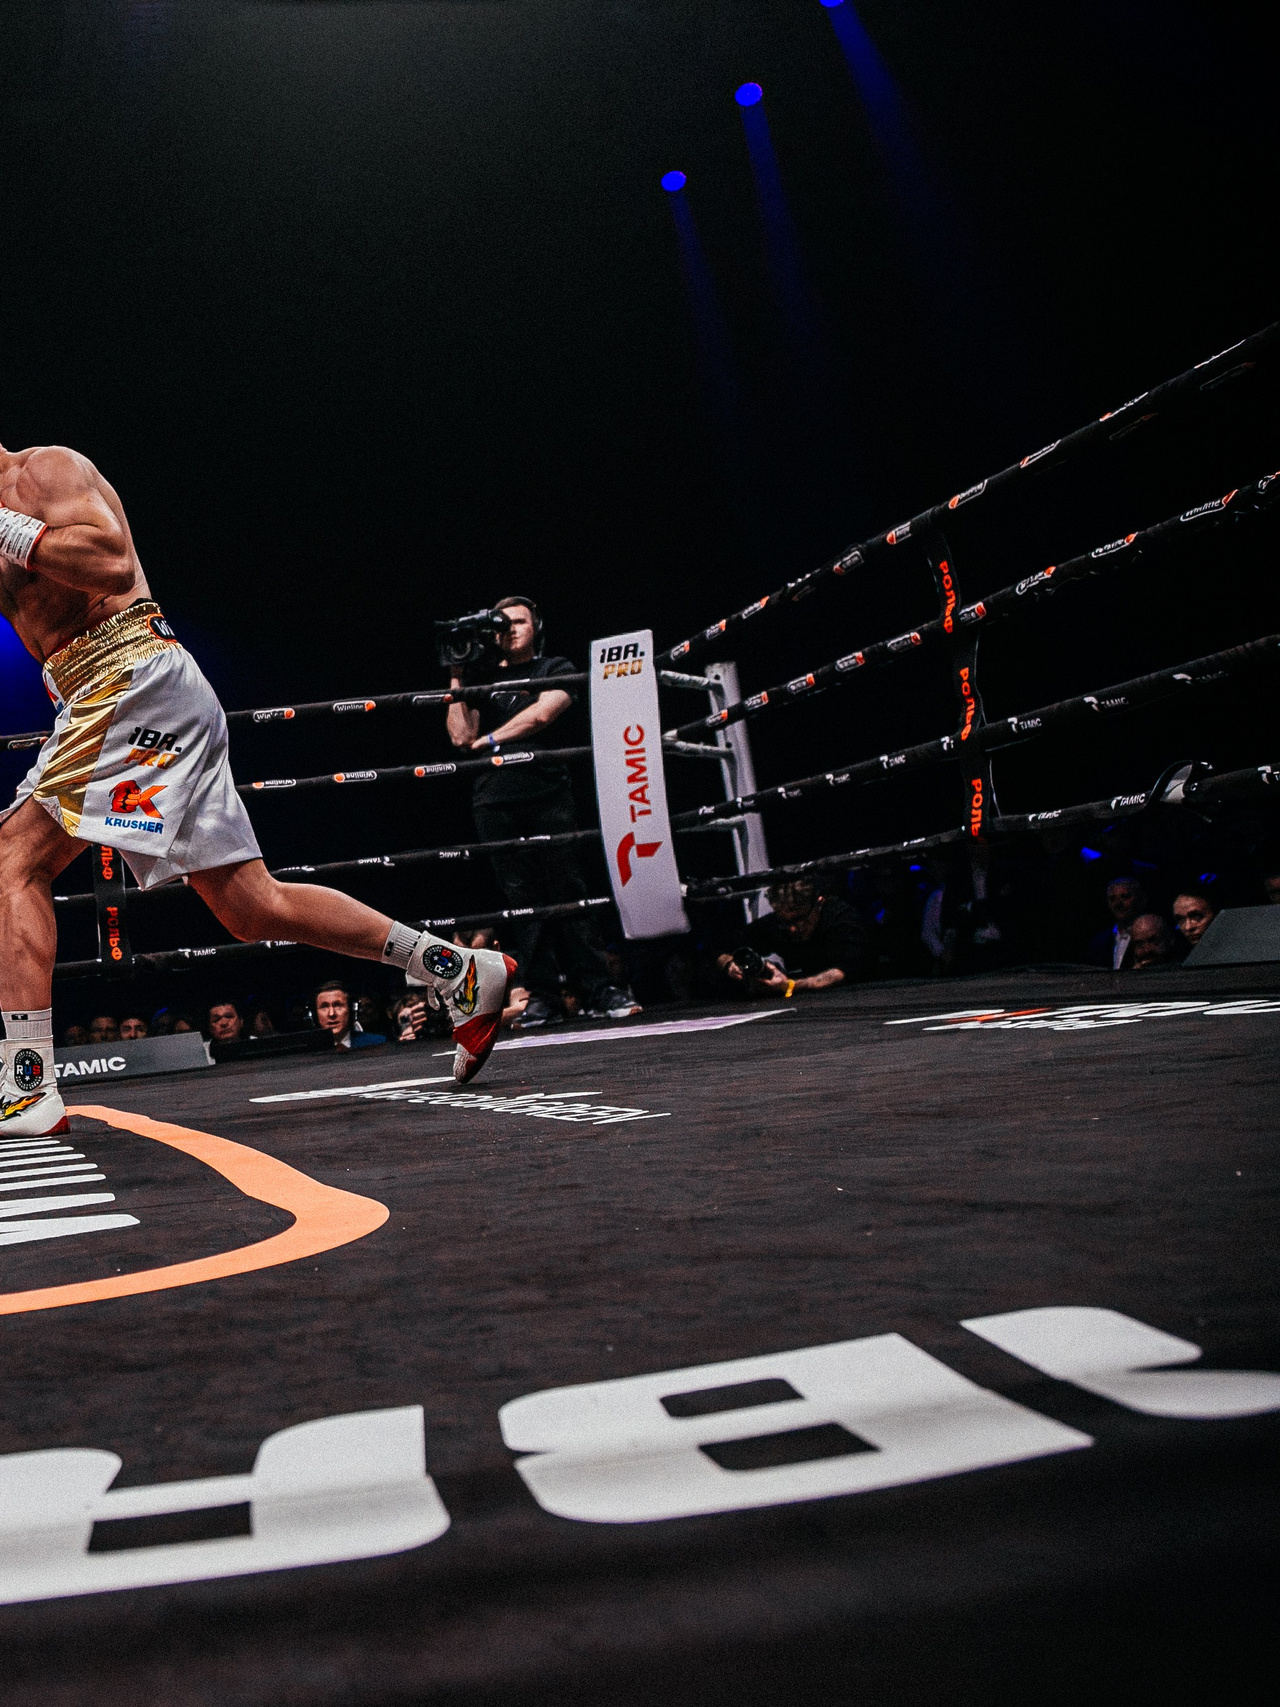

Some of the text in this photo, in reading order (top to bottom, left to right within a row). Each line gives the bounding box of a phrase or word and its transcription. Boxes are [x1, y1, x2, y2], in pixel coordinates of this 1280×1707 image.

[603, 659, 643, 680] PRO
[123, 748, 177, 770] PRO
[623, 724, 653, 823] TAMIC
[1119, 793, 1146, 807] TAMIC
[104, 816, 164, 834] KRUSHER
[432, 918, 456, 926] TAMIC
[192, 948, 216, 958] TAMIC
[429, 948, 452, 975] RUS
[16, 1064, 41, 1076] RUS
[54, 1056, 127, 1078] TAMIC
